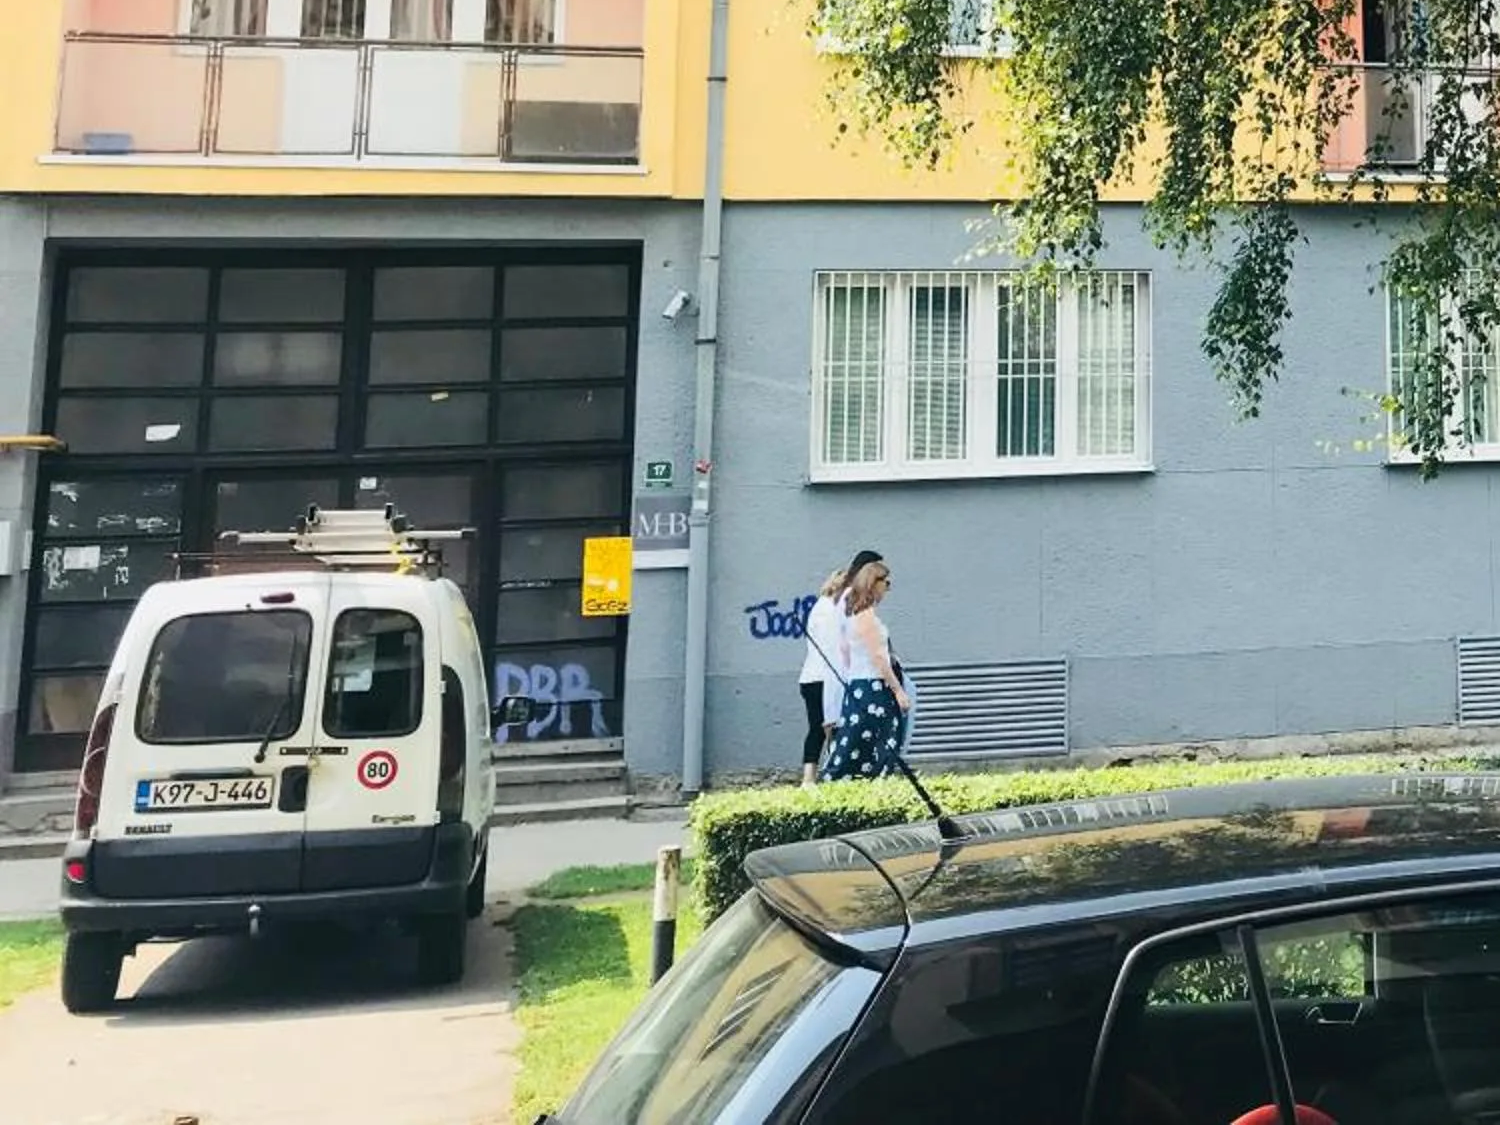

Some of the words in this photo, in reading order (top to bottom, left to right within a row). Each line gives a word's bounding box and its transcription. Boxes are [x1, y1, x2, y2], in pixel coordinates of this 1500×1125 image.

[653, 464, 668, 477] 17
[367, 762, 389, 778] 80
[153, 780, 268, 804] K97-J-446
